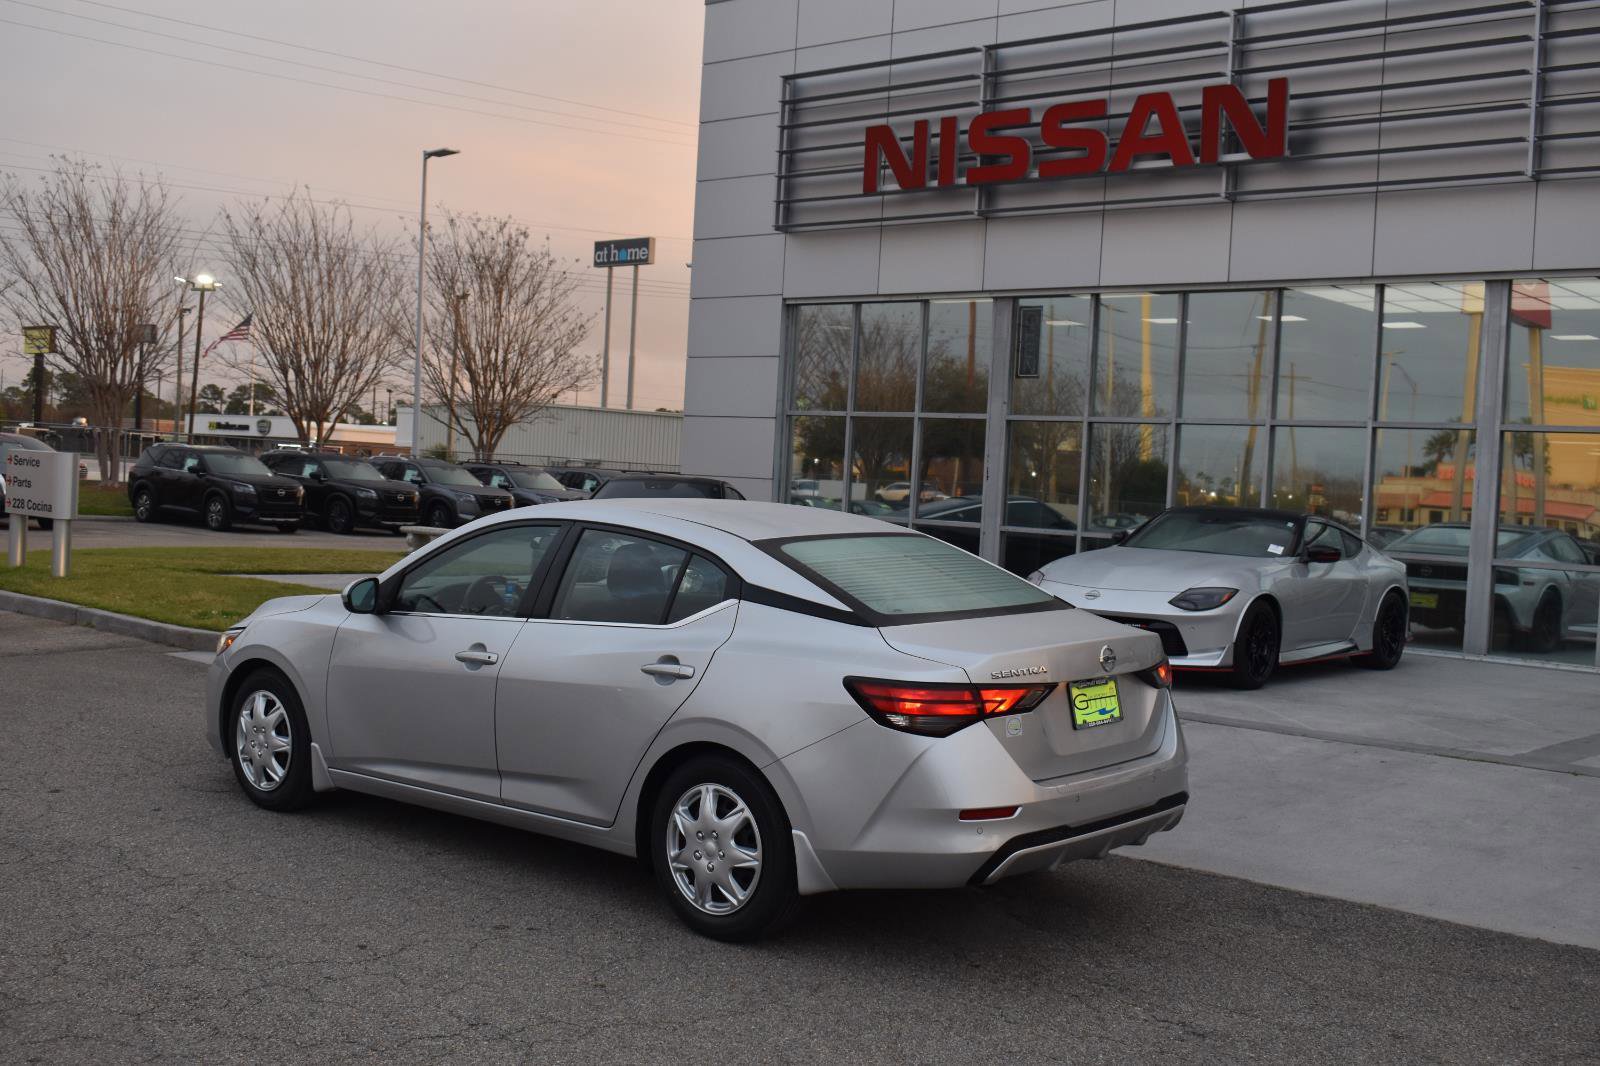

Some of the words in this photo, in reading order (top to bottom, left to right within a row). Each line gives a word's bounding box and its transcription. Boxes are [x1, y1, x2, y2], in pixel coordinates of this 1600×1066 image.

[862, 77, 1289, 195] NISSAN
[595, 247, 608, 263] at
[610, 244, 648, 261] home
[13, 455, 40, 467] Service
[13, 476, 32, 488] Parts
[12, 498, 25, 509] 228
[26, 499, 53, 512] Cocina
[991, 665, 1048, 680] SENTRA
